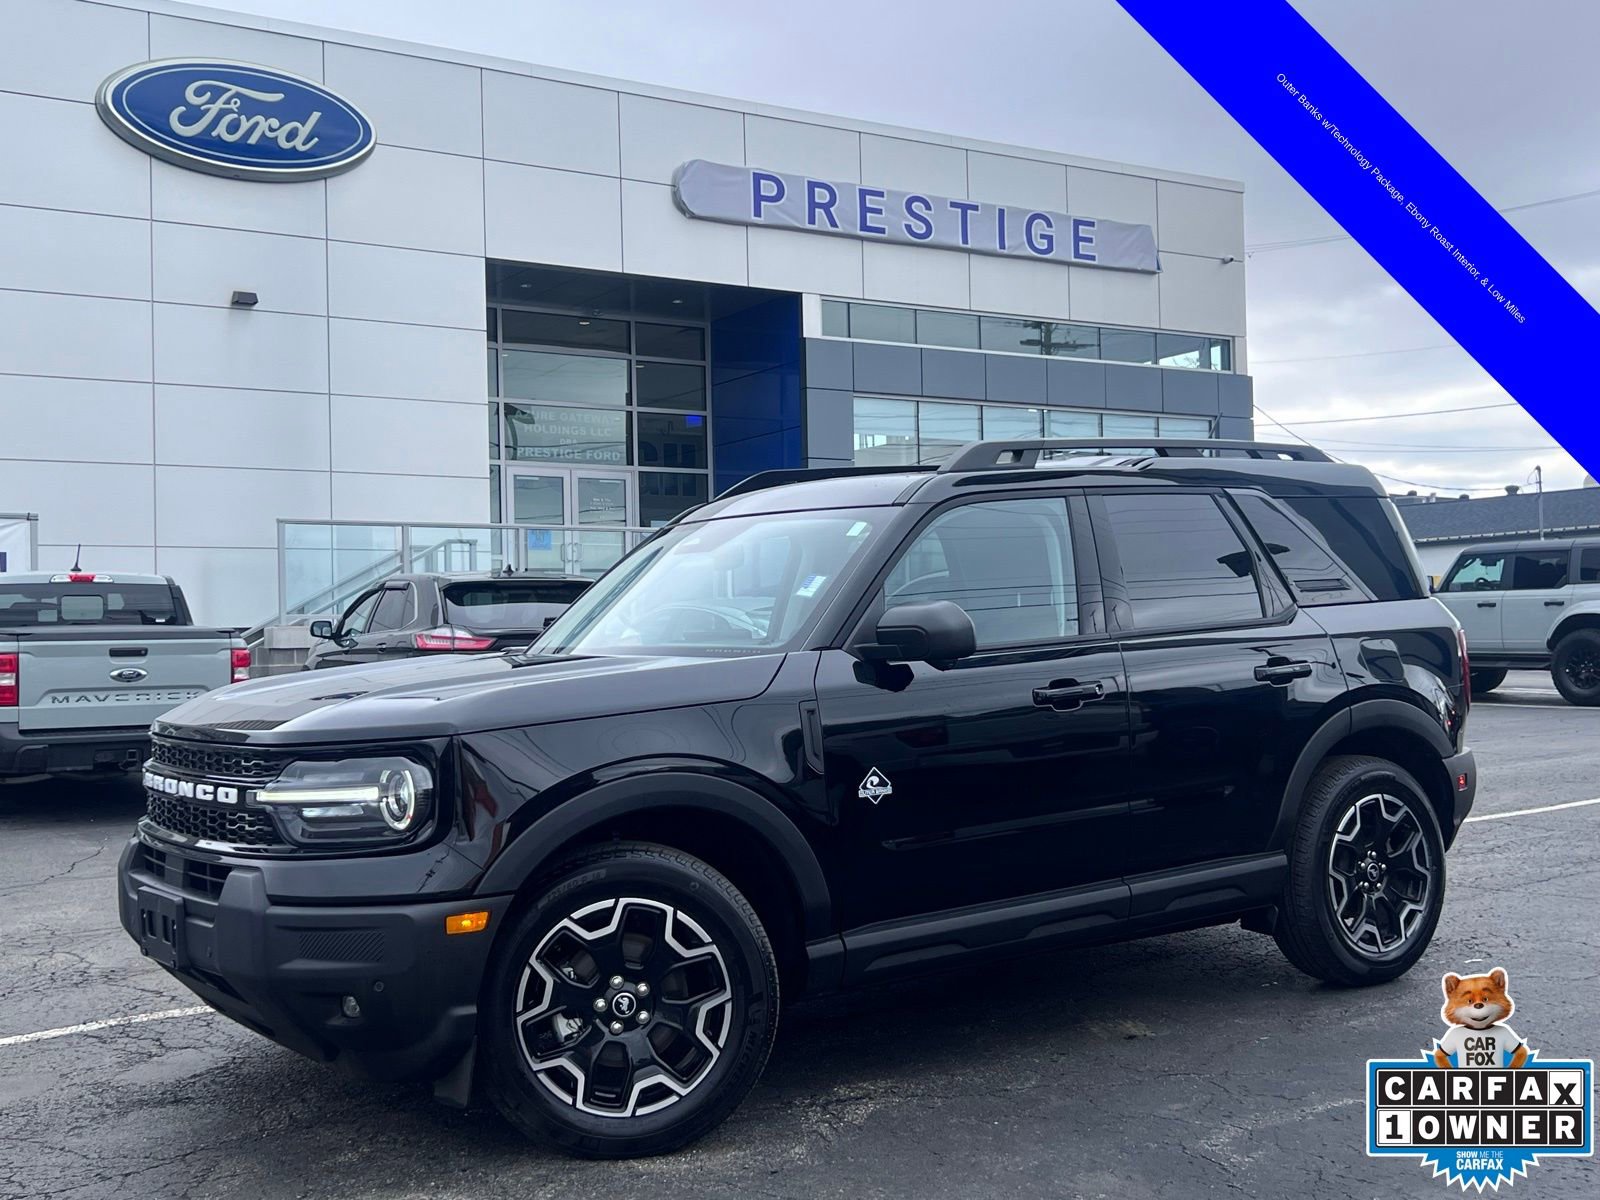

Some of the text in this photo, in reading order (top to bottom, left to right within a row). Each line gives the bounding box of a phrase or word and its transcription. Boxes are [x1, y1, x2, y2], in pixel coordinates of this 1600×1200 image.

[169, 80, 322, 152] Ford
[751, 170, 1098, 263] PRESTIGE
[515, 409, 557, 421] AURE
[523, 423, 612, 437] HOLDINGS LLC
[517, 446, 620, 461] PRESTIGE FORD
[51, 691, 200, 704] MAVERICK
[142, 771, 239, 805] BRONCO
